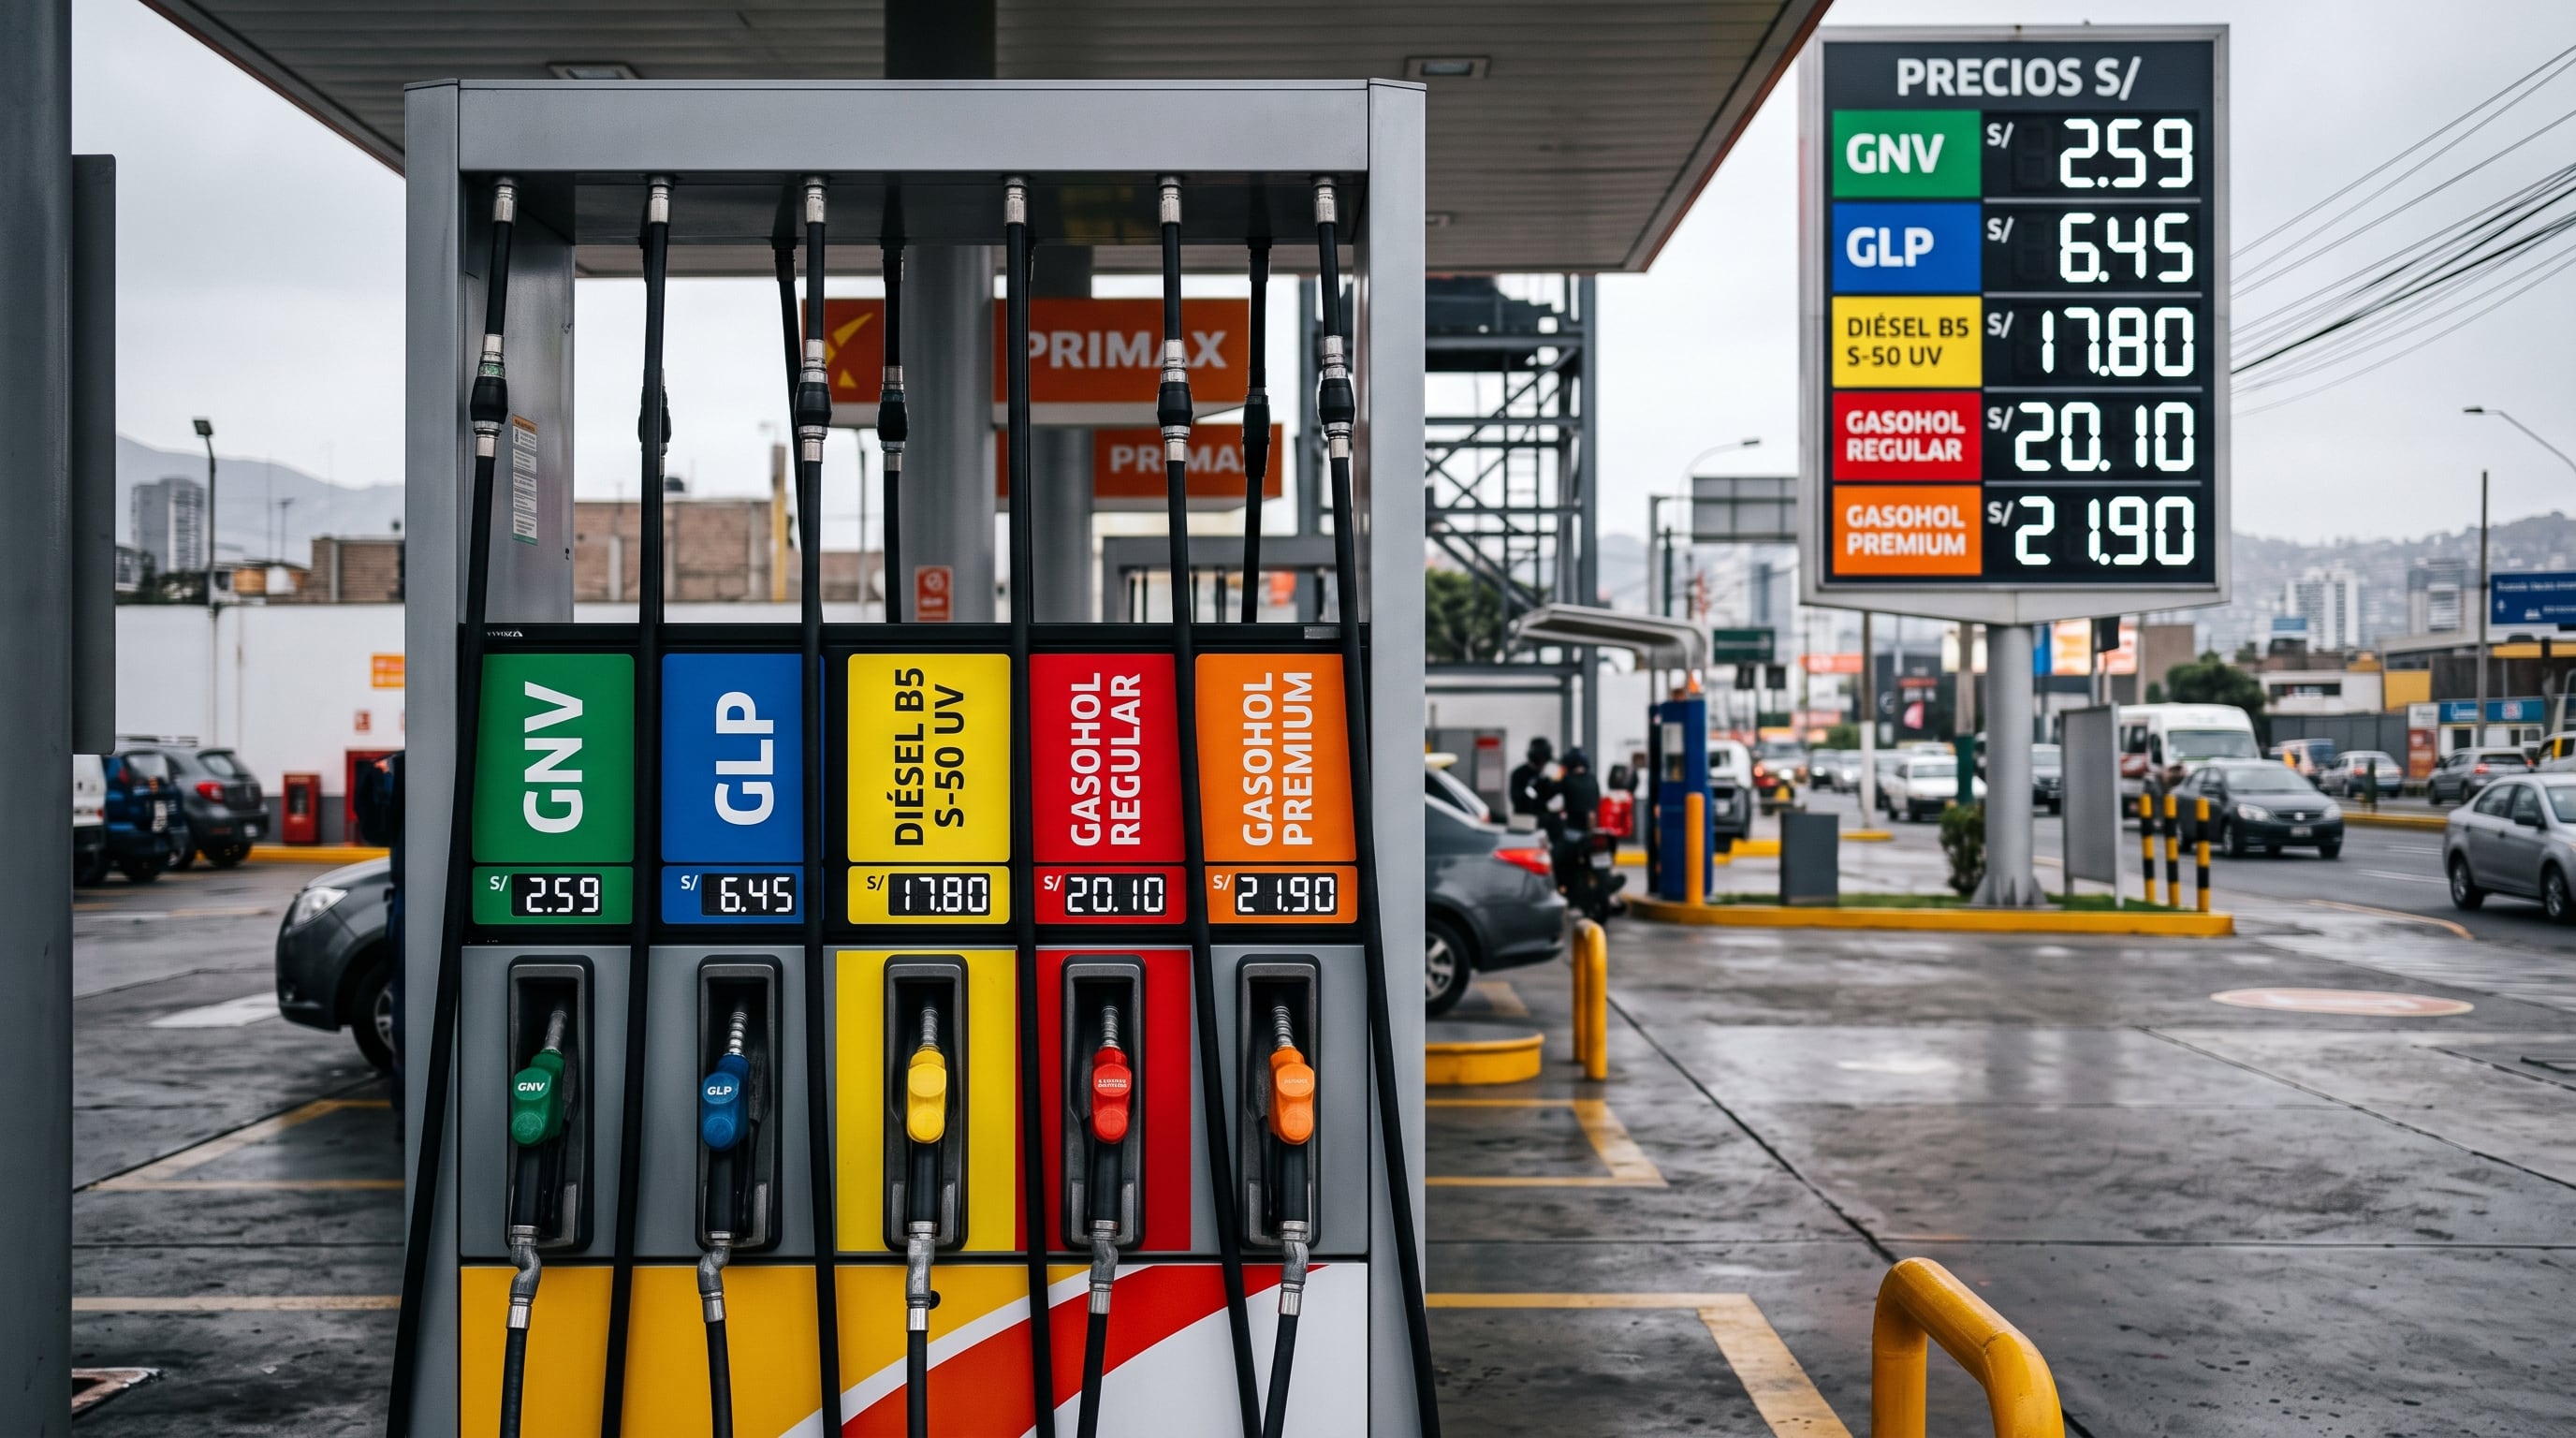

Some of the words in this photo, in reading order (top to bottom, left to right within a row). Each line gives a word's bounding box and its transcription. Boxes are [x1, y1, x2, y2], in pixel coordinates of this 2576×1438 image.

[1897, 57, 2083, 97] PRECIOS
[2094, 56, 2142, 101] S/
[1846, 133, 1945, 174] GNV
[1986, 122, 2014, 149] S/
[2059, 118, 2193, 188] 2.59
[1846, 227, 1935, 268] GLP
[1987, 216, 2014, 243] S/
[2059, 212, 2194, 283] 6.45
[1847, 314, 1931, 338] DIÉSEL
[1939, 316, 1969, 338] B5
[1987, 311, 2014, 339] S/
[2042, 306, 2194, 377] 17.80
[1847, 345, 1901, 367] S-50
[1909, 345, 1943, 367] UV
[1846, 410, 1966, 434] GASOHOL
[1987, 405, 2014, 433] S/
[2014, 402, 2194, 472] 20.10
[1111, 445, 1248, 473] PRMA
[1846, 437, 1963, 462] REGULAR
[1846, 505, 1966, 529] GASOHOL
[1987, 500, 2014, 527] S/
[2014, 495, 2195, 565] 21.90
[1846, 532, 1967, 556] PREMIUM
[894, 668, 925, 712] B5
[934, 683, 965, 735] UV
[522, 681, 584, 834] GNV
[714, 691, 775, 826] GLP
[1070, 672, 1102, 846] GASOHOL
[1110, 673, 1141, 845] REGULAR
[1242, 672, 1274, 846] GASOHOL
[1282, 672, 1313, 845] PREMIUM
[886, 723, 925, 846] DIÉSEL
[934, 746, 965, 828] S-50
[490, 874, 508, 892] S/
[526, 877, 599, 913] 2.59
[681, 874, 699, 891] S/
[720, 876, 793, 913] 6.45
[867, 874, 885, 891] S/
[904, 876, 988, 913] 17.80
[1044, 874, 1062, 892] S/
[1067, 876, 1164, 913] 20.10
[1212, 873, 1232, 891] S/
[1237, 876, 1335, 913] 21.90
[517, 1082, 546, 1092] GNV
[707, 1085, 733, 1095] GLP
